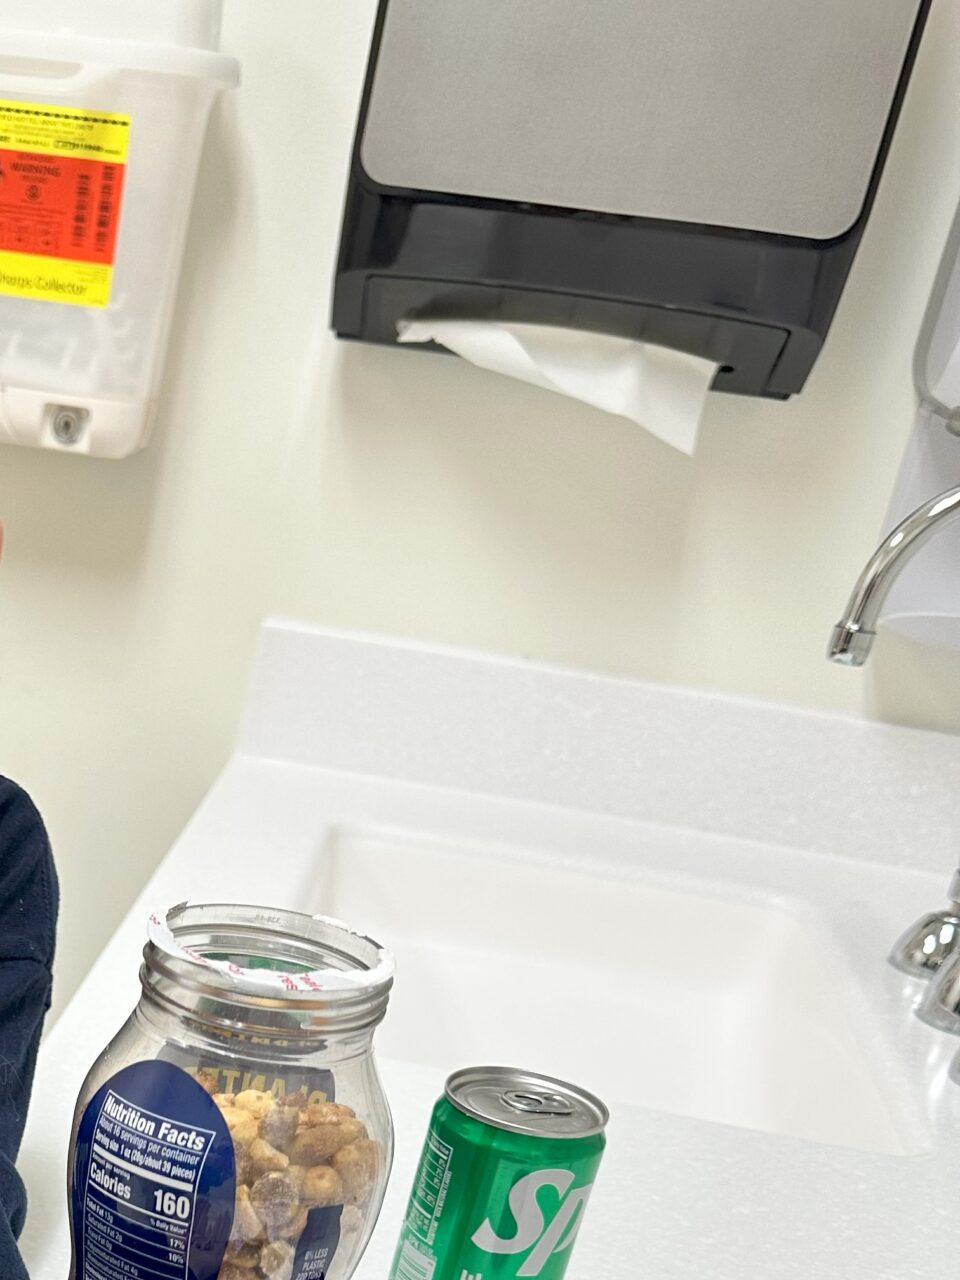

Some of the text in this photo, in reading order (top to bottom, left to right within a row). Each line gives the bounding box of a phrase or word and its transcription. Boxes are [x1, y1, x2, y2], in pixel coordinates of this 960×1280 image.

[99, 1114, 200, 1166] About 16 servings per container
[103, 1094, 207, 1152] Nutrition Facts
[94, 1128, 197, 1182] Serving size 1 oz (28g/about 39 pieces)
[105, 1162, 113, 1170] per
[112, 1166, 131, 1180] serving
[89, 1161, 191, 1220] Calories 160
[94, 1204, 106, 1217] Fat
[102, 1210, 116, 1223] 13g
[168, 1237, 186, 1250] 17%
[96, 1234, 107, 1245] Fat
[103, 1239, 113, 1251] 0g
[105, 1226, 117, 1238] Fat
[113, 1231, 124, 1242] 2g
[167, 1252, 185, 1265] 10%
[118, 1260, 139, 1276] Fat 4g
[300, 1258, 326, 1271] PLASTIC
[313, 1247, 329, 1258] LESS
